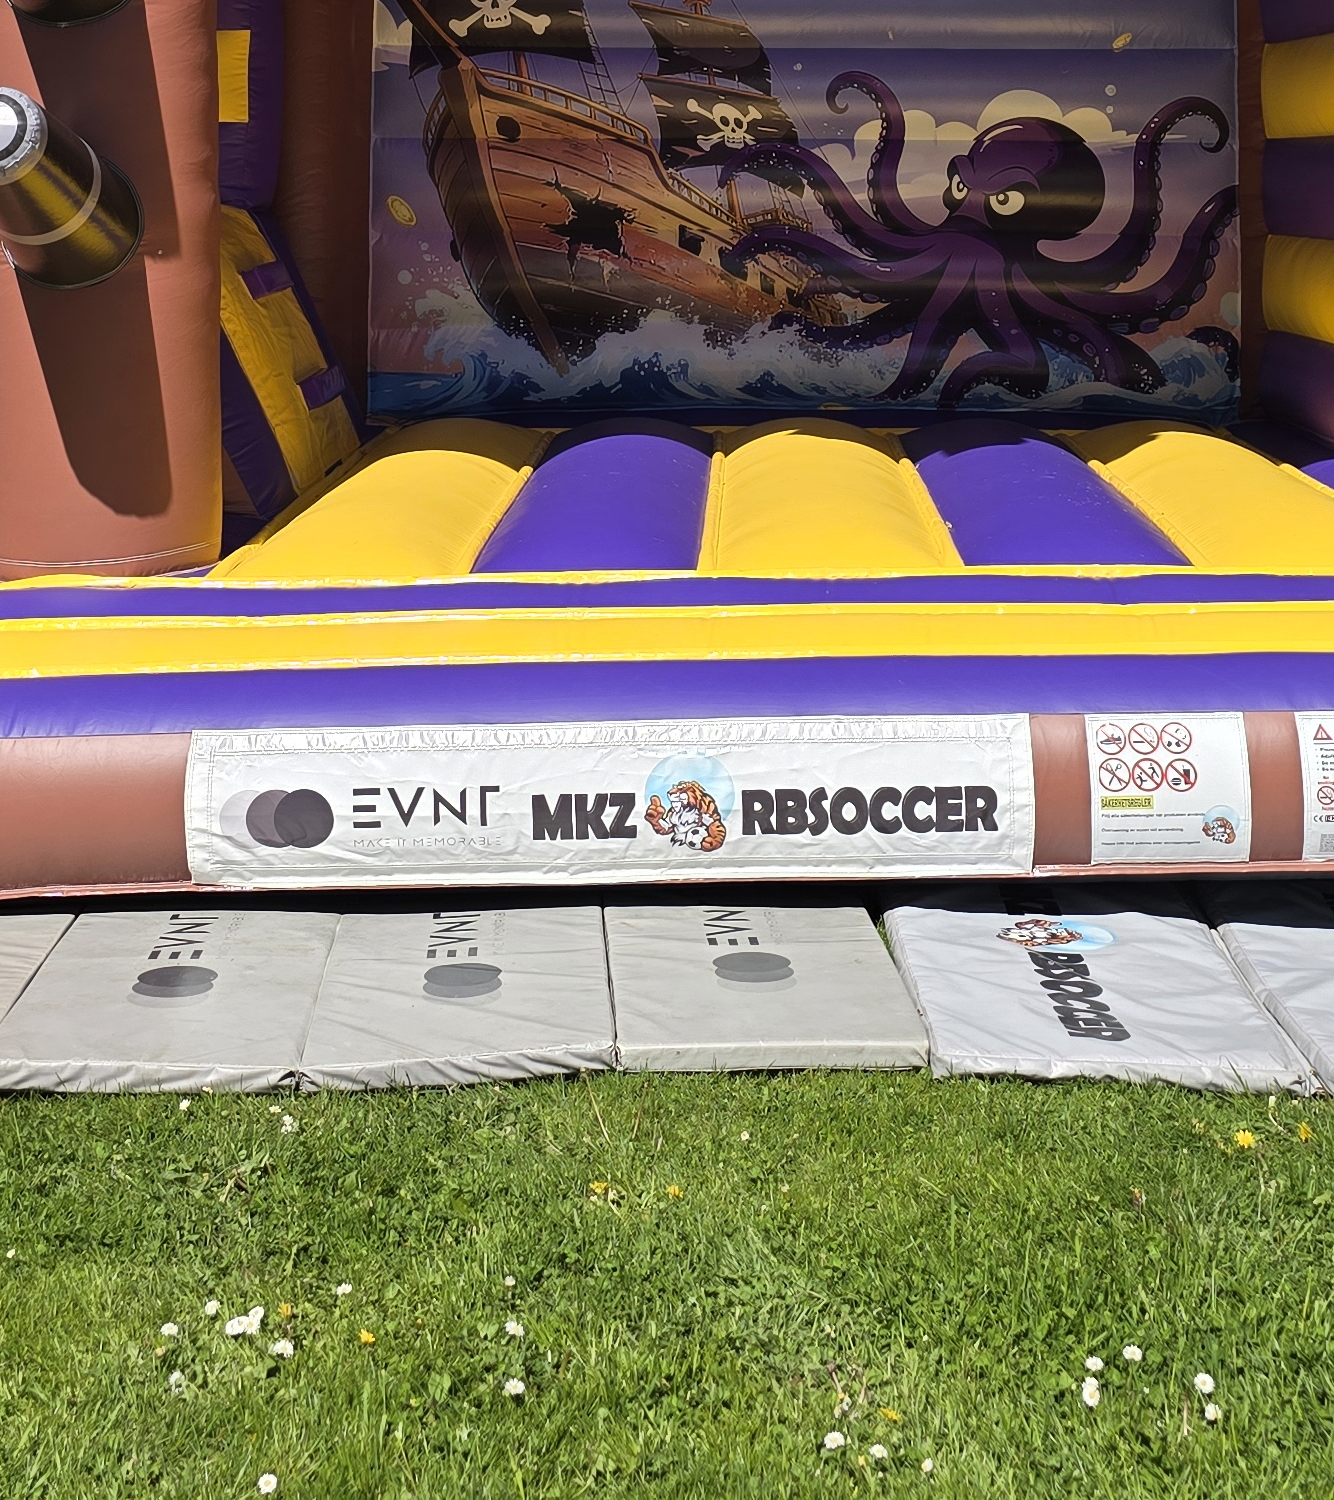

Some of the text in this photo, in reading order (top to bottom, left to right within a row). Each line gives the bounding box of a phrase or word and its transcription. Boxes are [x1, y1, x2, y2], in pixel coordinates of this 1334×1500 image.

[353, 785, 998, 840] EVNT MKZ RBSOCCER
[354, 836, 501, 847] MAKE IT MEMORABLE
[703, 910, 759, 945] EVN
